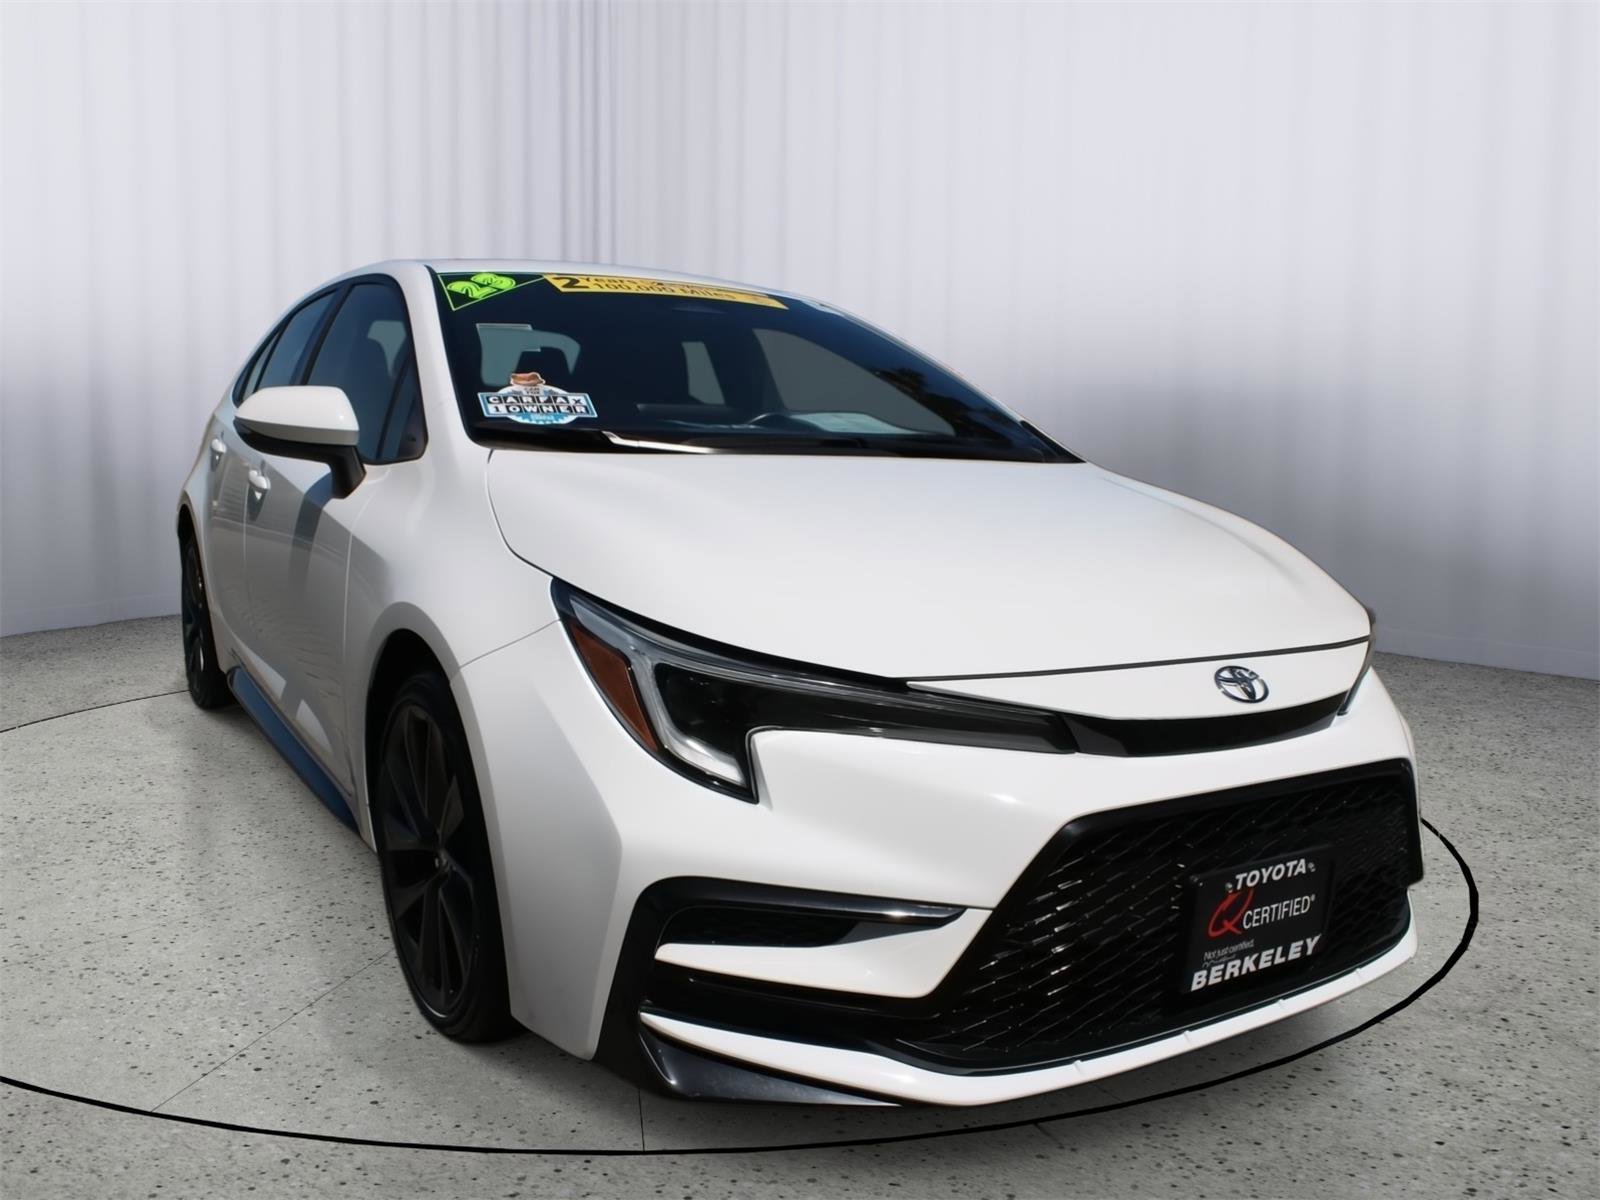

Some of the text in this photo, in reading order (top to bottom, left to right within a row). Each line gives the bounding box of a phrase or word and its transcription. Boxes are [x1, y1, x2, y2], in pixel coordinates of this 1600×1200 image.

[488, 394, 585, 405] CARFAX
[508, 404, 587, 414] OWNER
[1235, 858, 1307, 891] TOYOTA
[1190, 933, 1322, 992] BERKELEY
